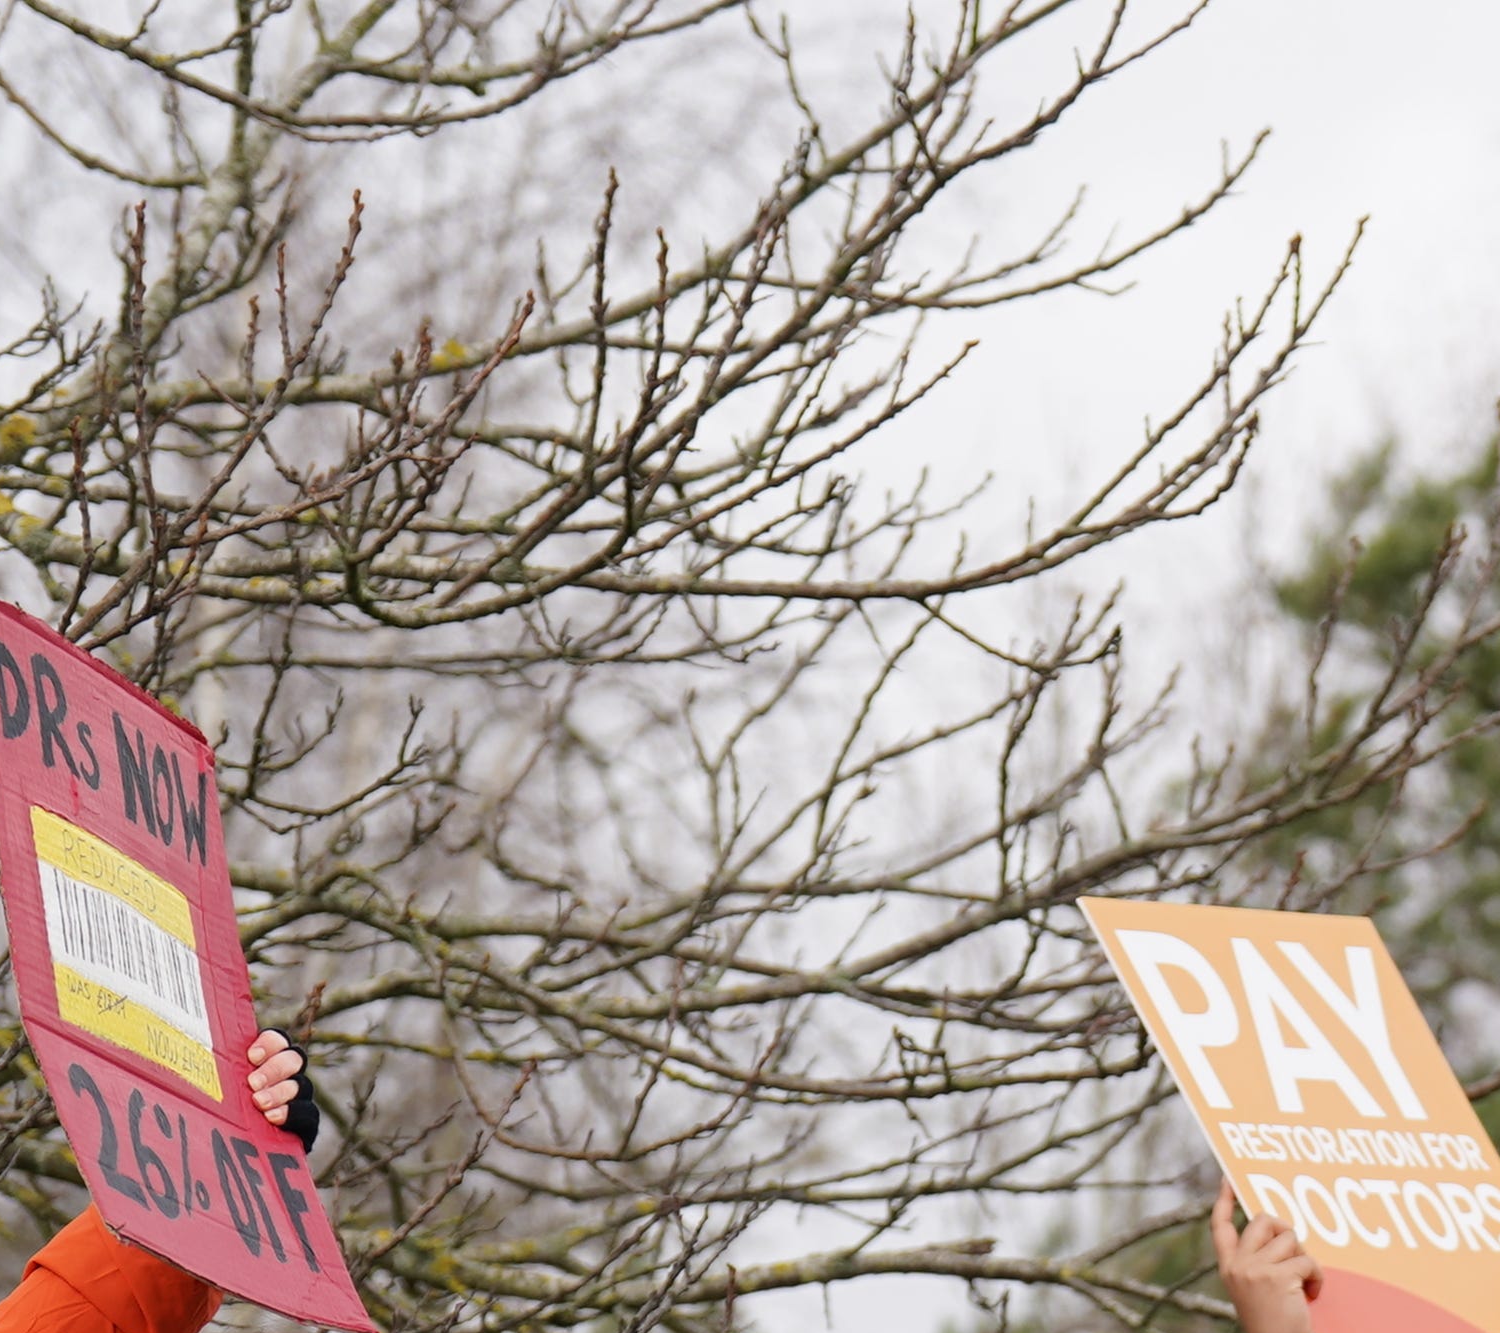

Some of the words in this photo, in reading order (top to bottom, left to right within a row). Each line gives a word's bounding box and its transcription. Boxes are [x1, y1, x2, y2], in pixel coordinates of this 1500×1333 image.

[112, 712, 210, 868] NOW
[62, 829, 156, 912] REDUCED
[66, 975, 91, 1000] WAS
[1114, 928, 1428, 1121] PAY
[69, 1062, 209, 1219] 26%
[211, 1128, 319, 1272] OFF
[1219, 1121, 1425, 1168] RESTORATION
[1424, 1132, 1490, 1172] FOR
